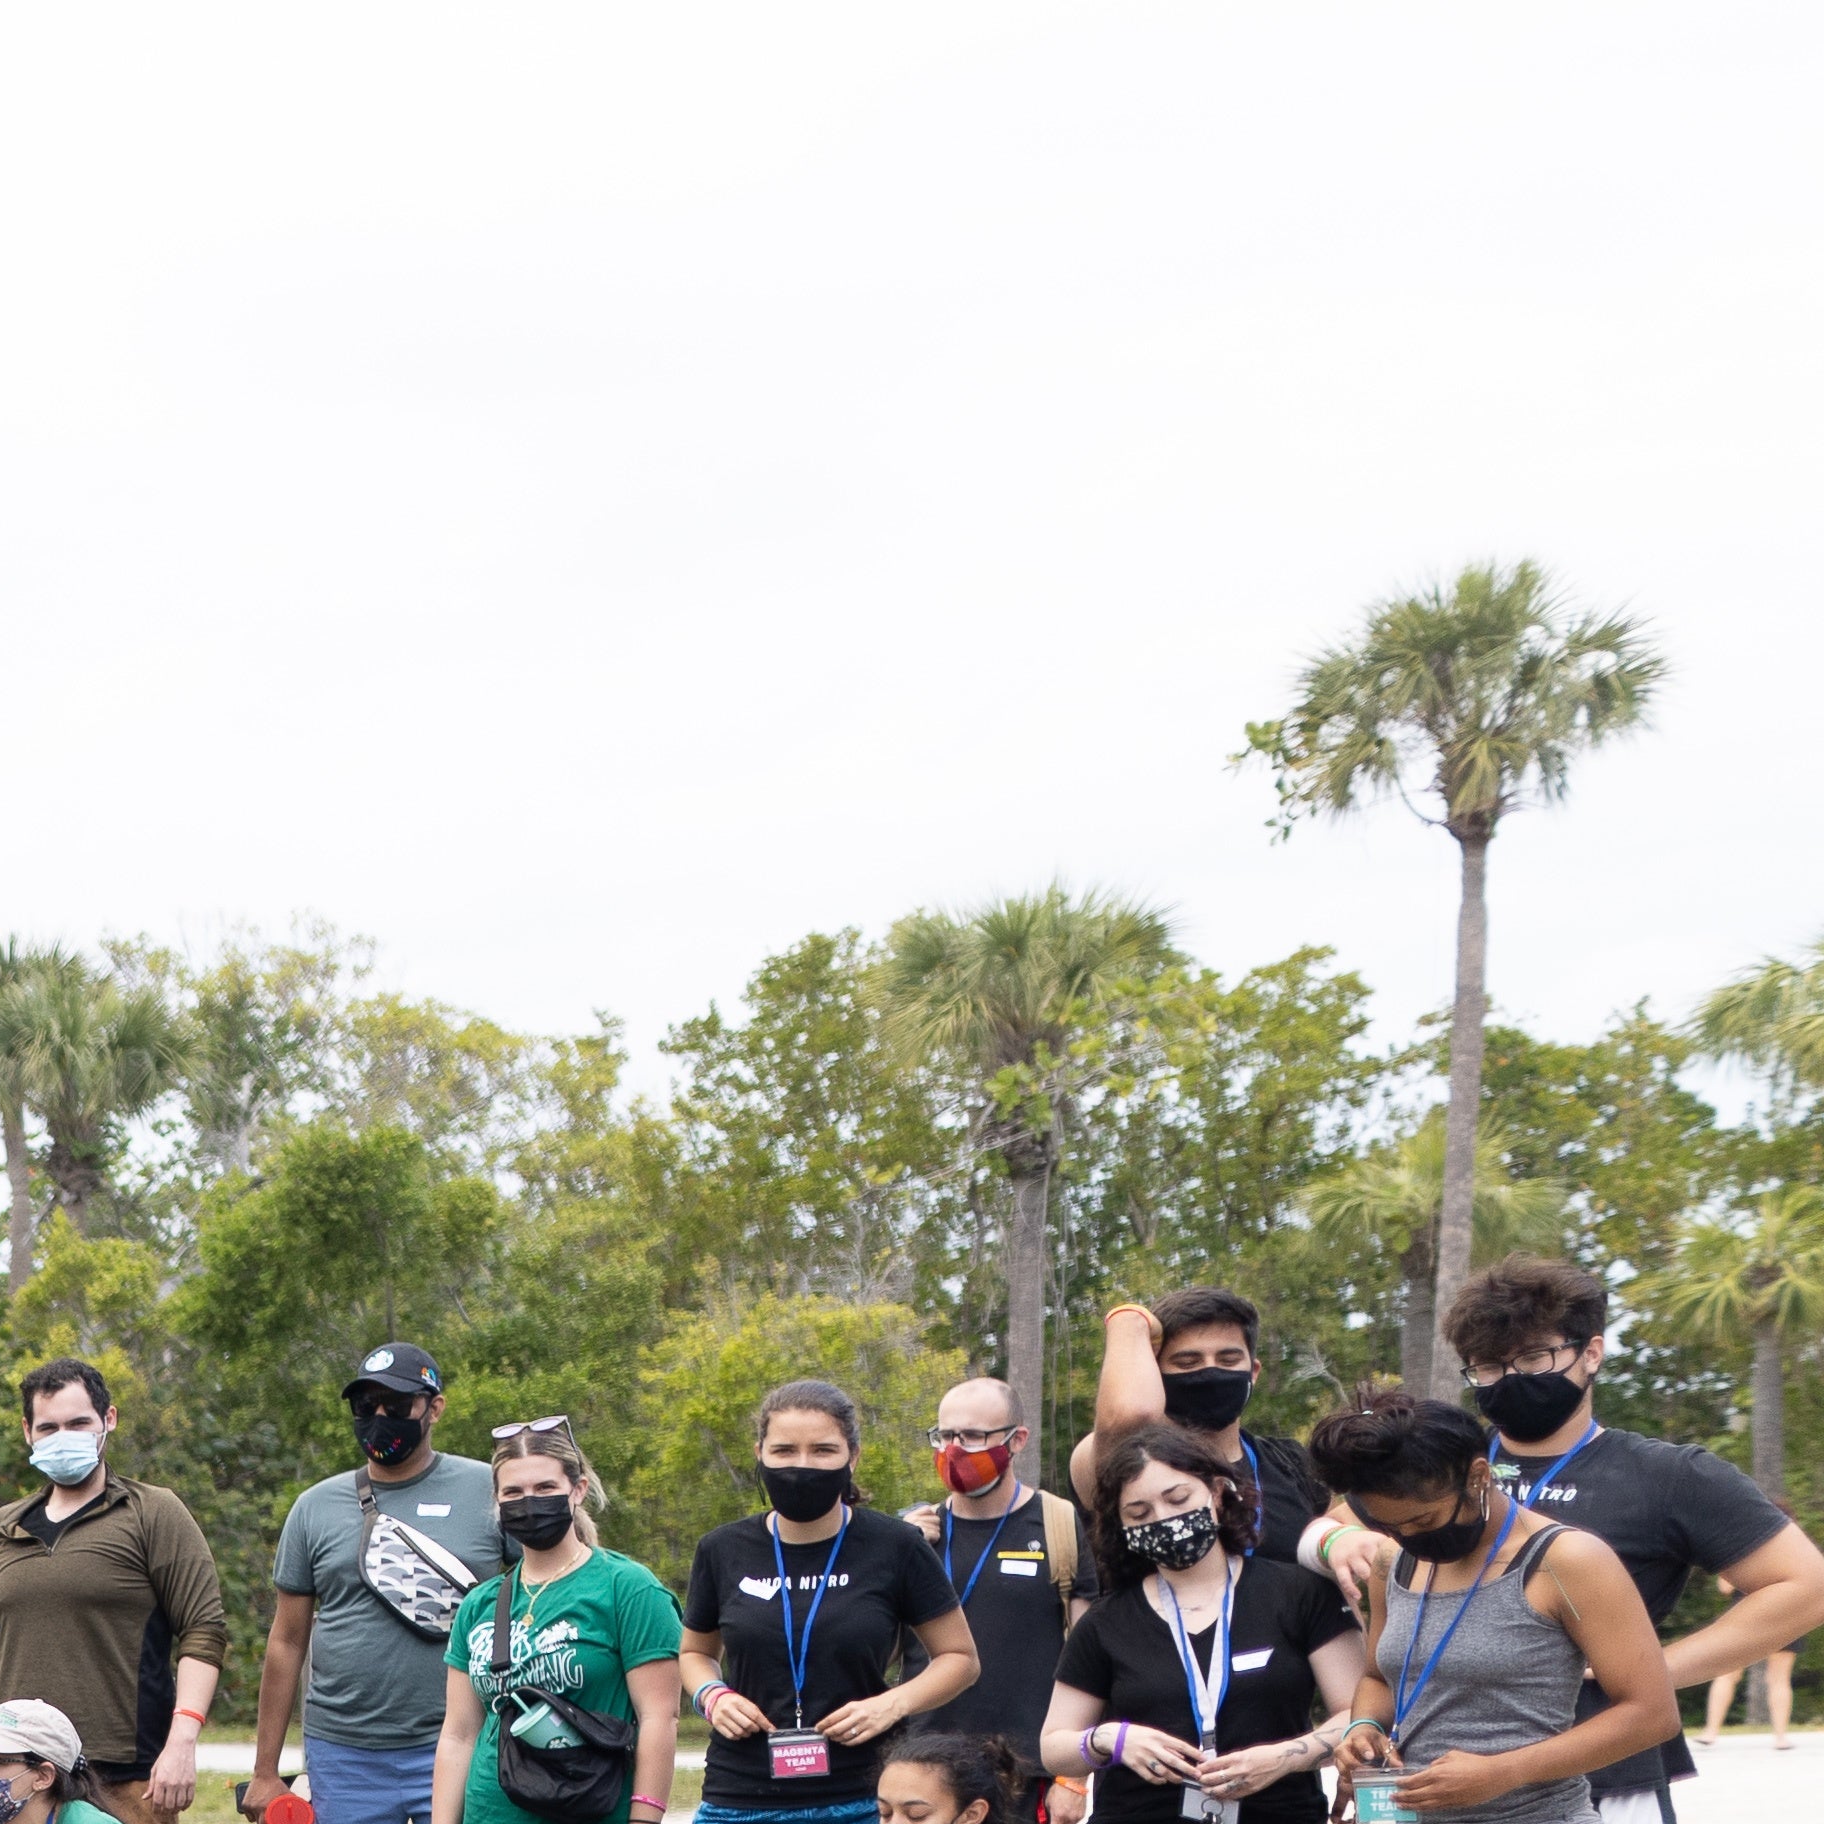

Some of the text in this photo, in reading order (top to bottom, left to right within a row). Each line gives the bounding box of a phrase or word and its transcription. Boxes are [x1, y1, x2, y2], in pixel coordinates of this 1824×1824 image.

[1518, 1484, 1578, 1502] NTRO
[757, 1576, 792, 1590] HOA
[773, 1745, 826, 1758] MAGENTA
[784, 1756, 816, 1768] TEAM
[1370, 1789, 1398, 1800] TEA
